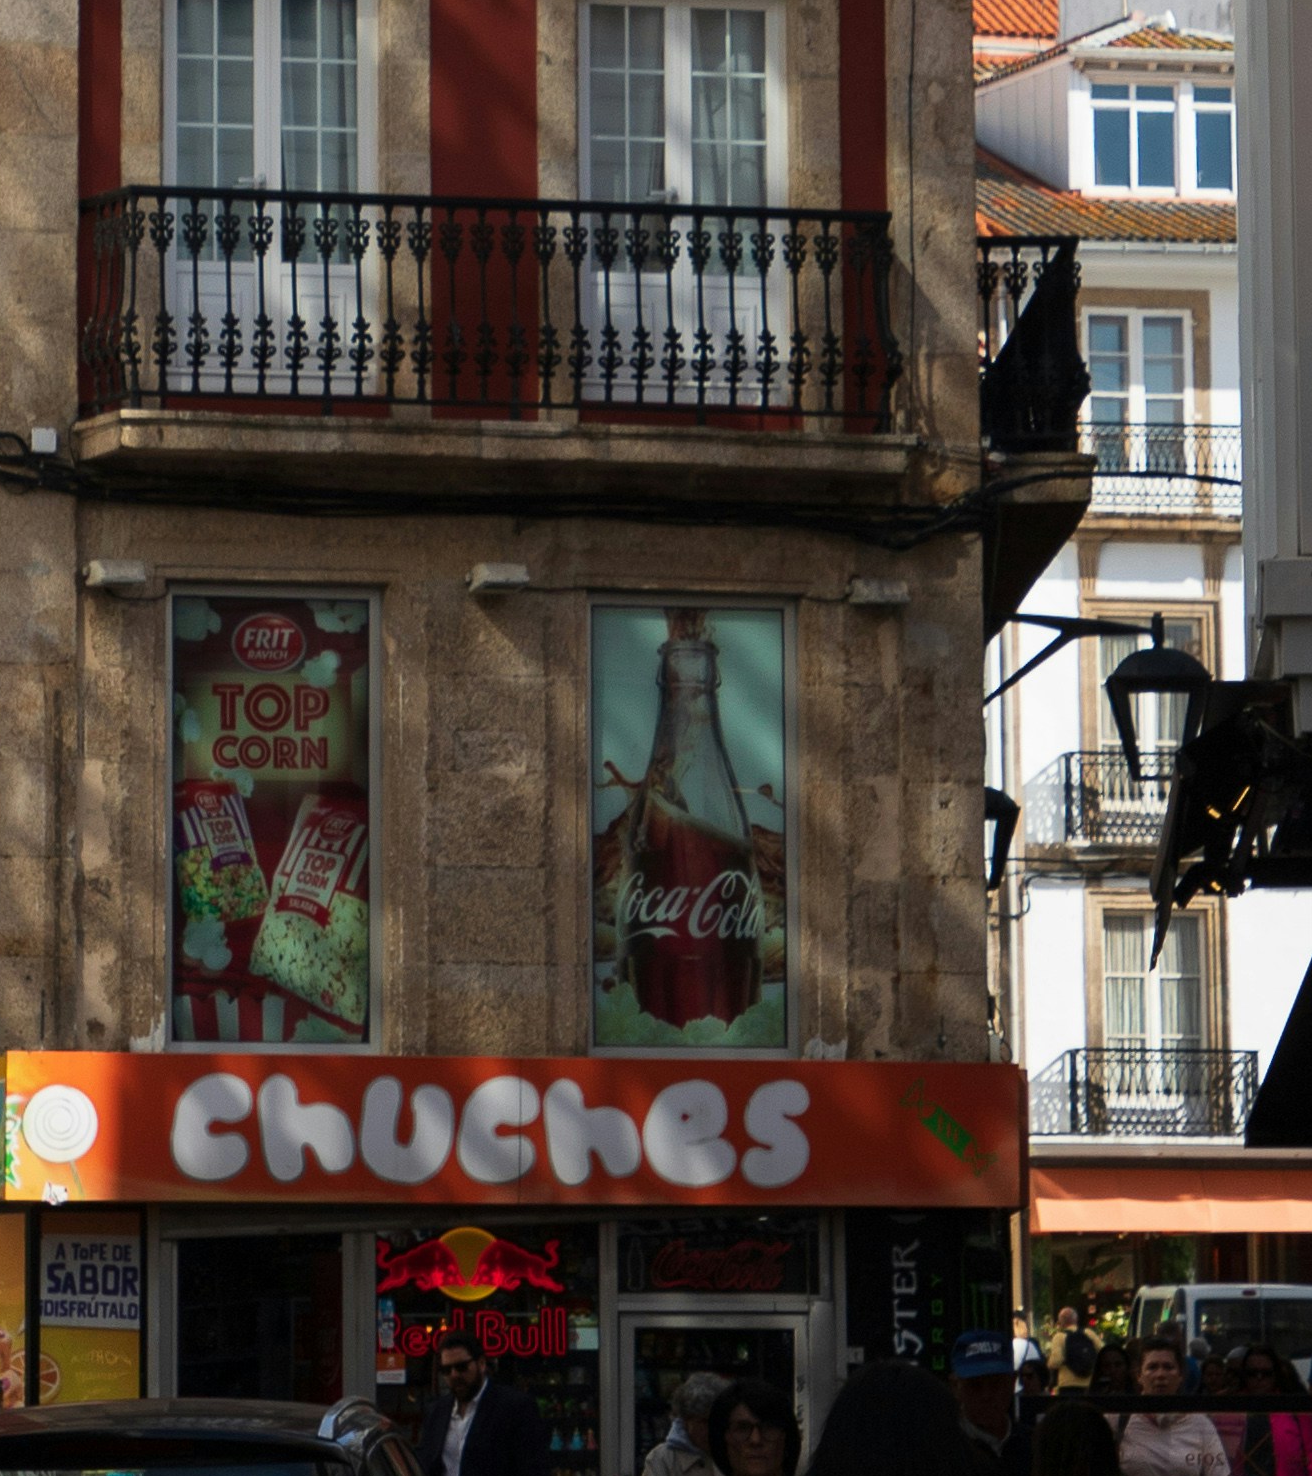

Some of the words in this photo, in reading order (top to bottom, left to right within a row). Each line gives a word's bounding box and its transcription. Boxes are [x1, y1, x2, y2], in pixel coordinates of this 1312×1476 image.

[242, 628, 295, 649] FRIT
[247, 650, 289, 660] RAVICH
[212, 682, 330, 733] TOP
[212, 734, 329, 770] CORN
[305, 853, 337, 872] TOP
[296, 871, 330, 891] CORN
[616, 870, 766, 940] Coca-Cola
[55, 1242, 66, 1260] A
[112, 1245, 132, 1262] DE
[891, 1238, 924, 1356] STER
[475, 1306, 568, 1358] Bull
[929, 1273, 946, 1371] ERGY
